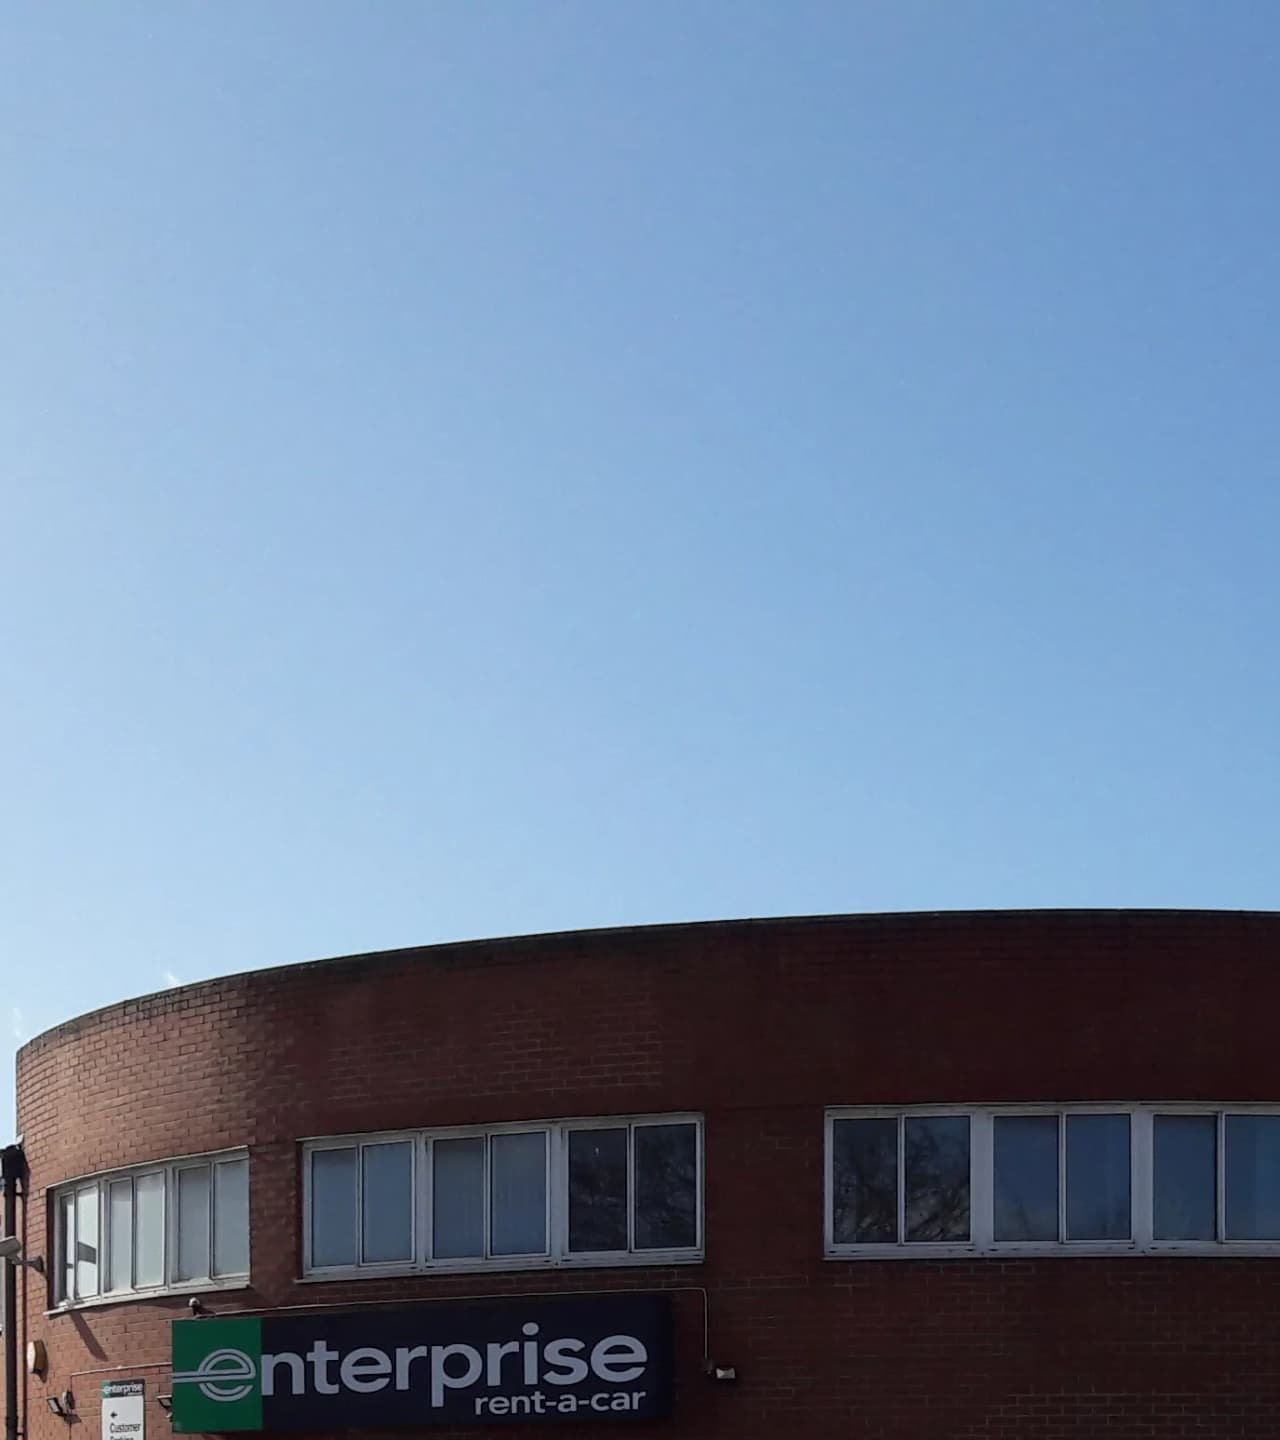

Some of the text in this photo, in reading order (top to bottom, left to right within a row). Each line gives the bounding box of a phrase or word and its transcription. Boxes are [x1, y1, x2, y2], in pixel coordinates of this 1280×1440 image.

[172, 1322, 648, 1408] enterprise
[475, 1390, 647, 1416] rent-a-car
[110, 1423, 141, 1433] Customer
